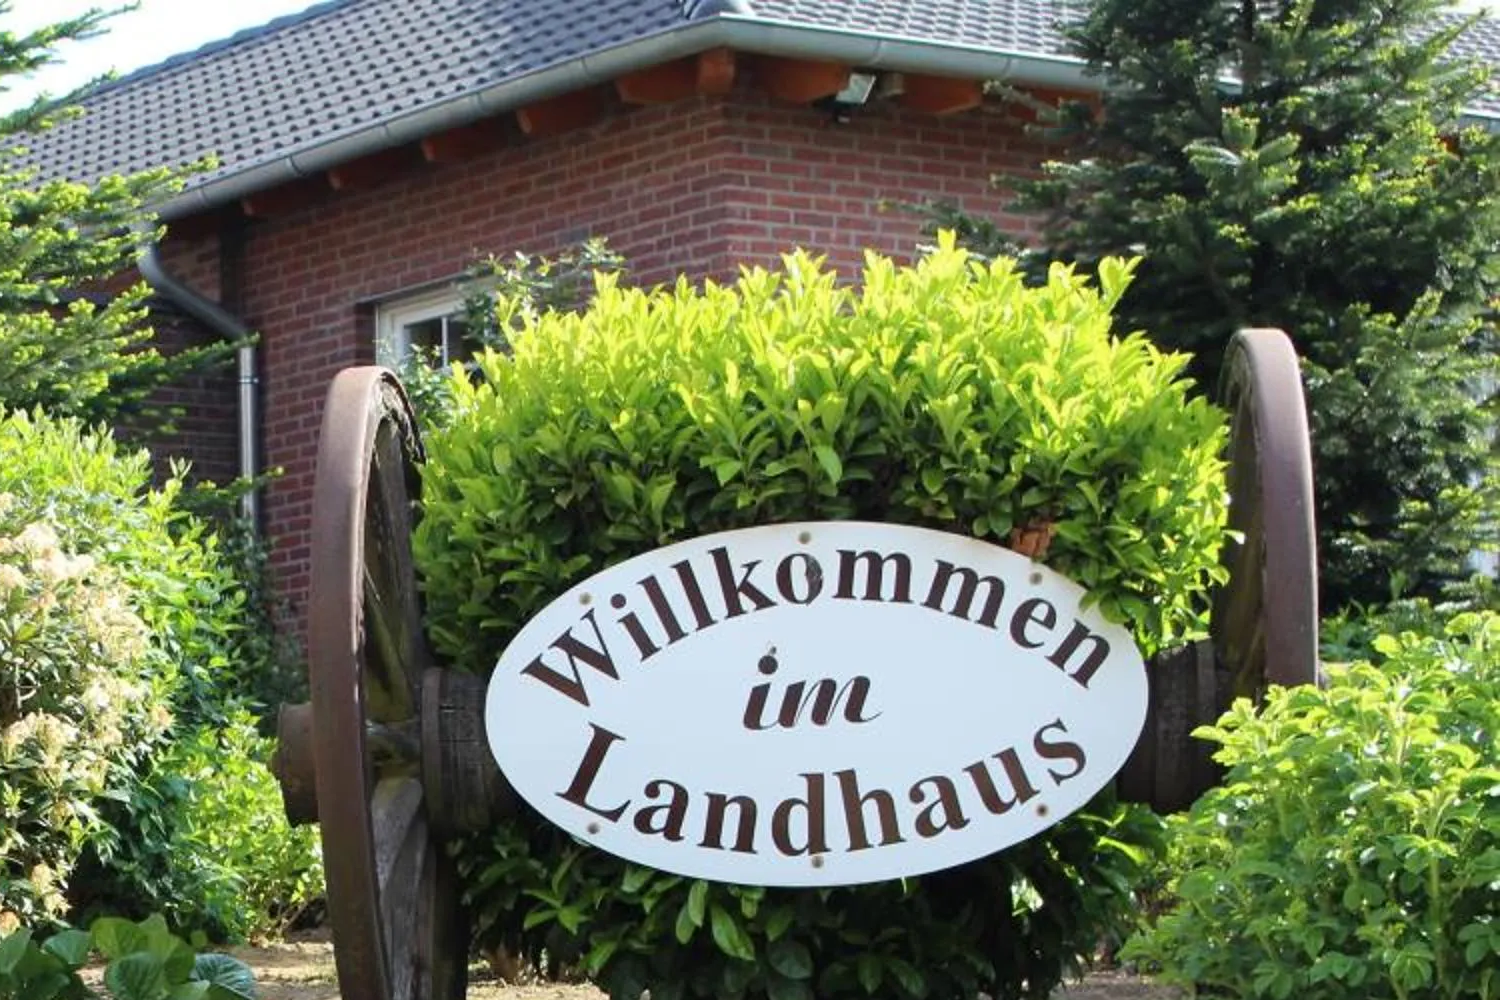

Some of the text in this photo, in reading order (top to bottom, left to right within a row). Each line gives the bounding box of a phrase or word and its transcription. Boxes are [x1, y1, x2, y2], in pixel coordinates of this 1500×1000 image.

[520, 546, 1112, 708] Willkommen
[742, 653, 882, 732] im
[554, 717, 1088, 857] Landhaus
